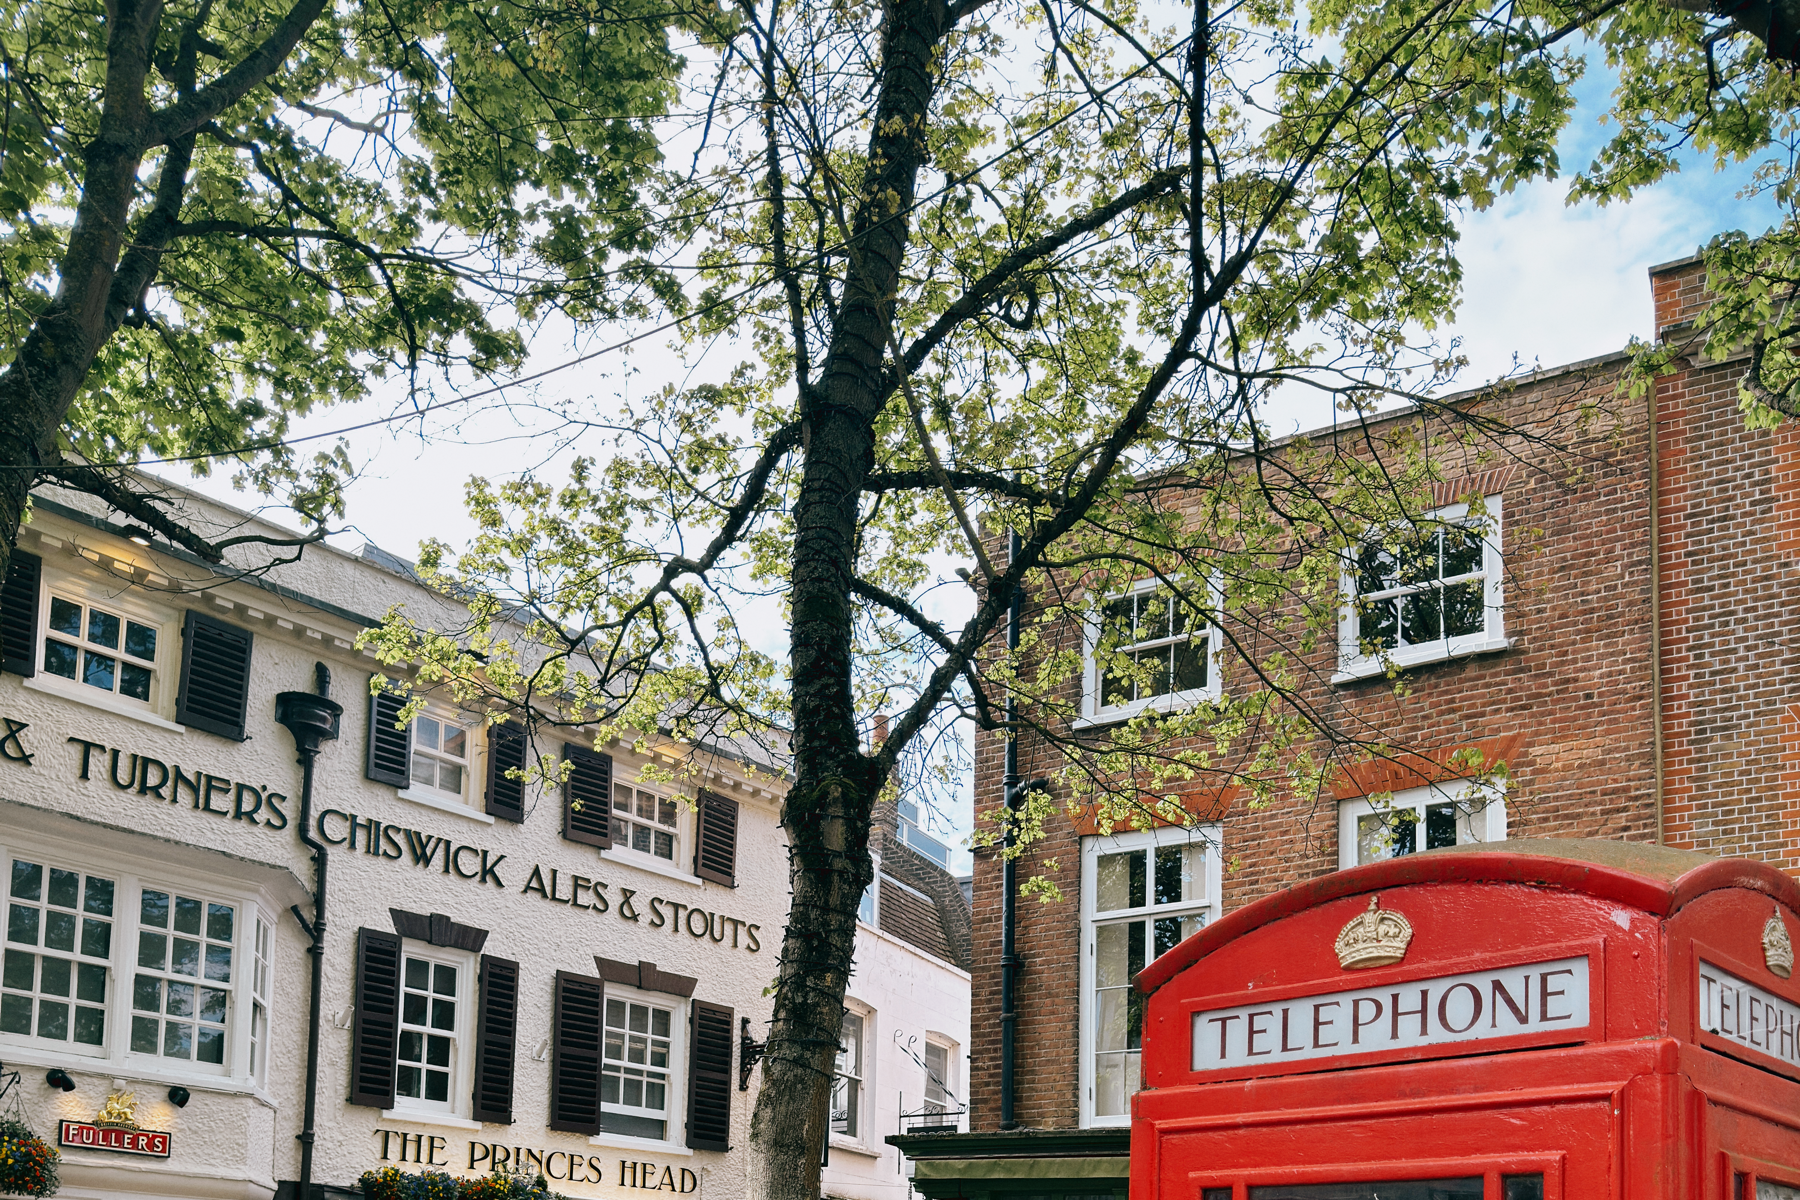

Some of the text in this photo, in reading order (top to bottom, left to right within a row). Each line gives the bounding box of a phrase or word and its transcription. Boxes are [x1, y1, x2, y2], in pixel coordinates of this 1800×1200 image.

[0, 717, 287, 831] & TURNER'S
[317, 808, 762, 953] CHISWICK ALES & STOUTS
[1207, 968, 1575, 1060] TELEPHONE
[1700, 973, 1800, 1064] TELEPH
[68, 1125, 163, 1152] FULLER'S
[373, 1129, 697, 1194] THE PRINCES HEAD
